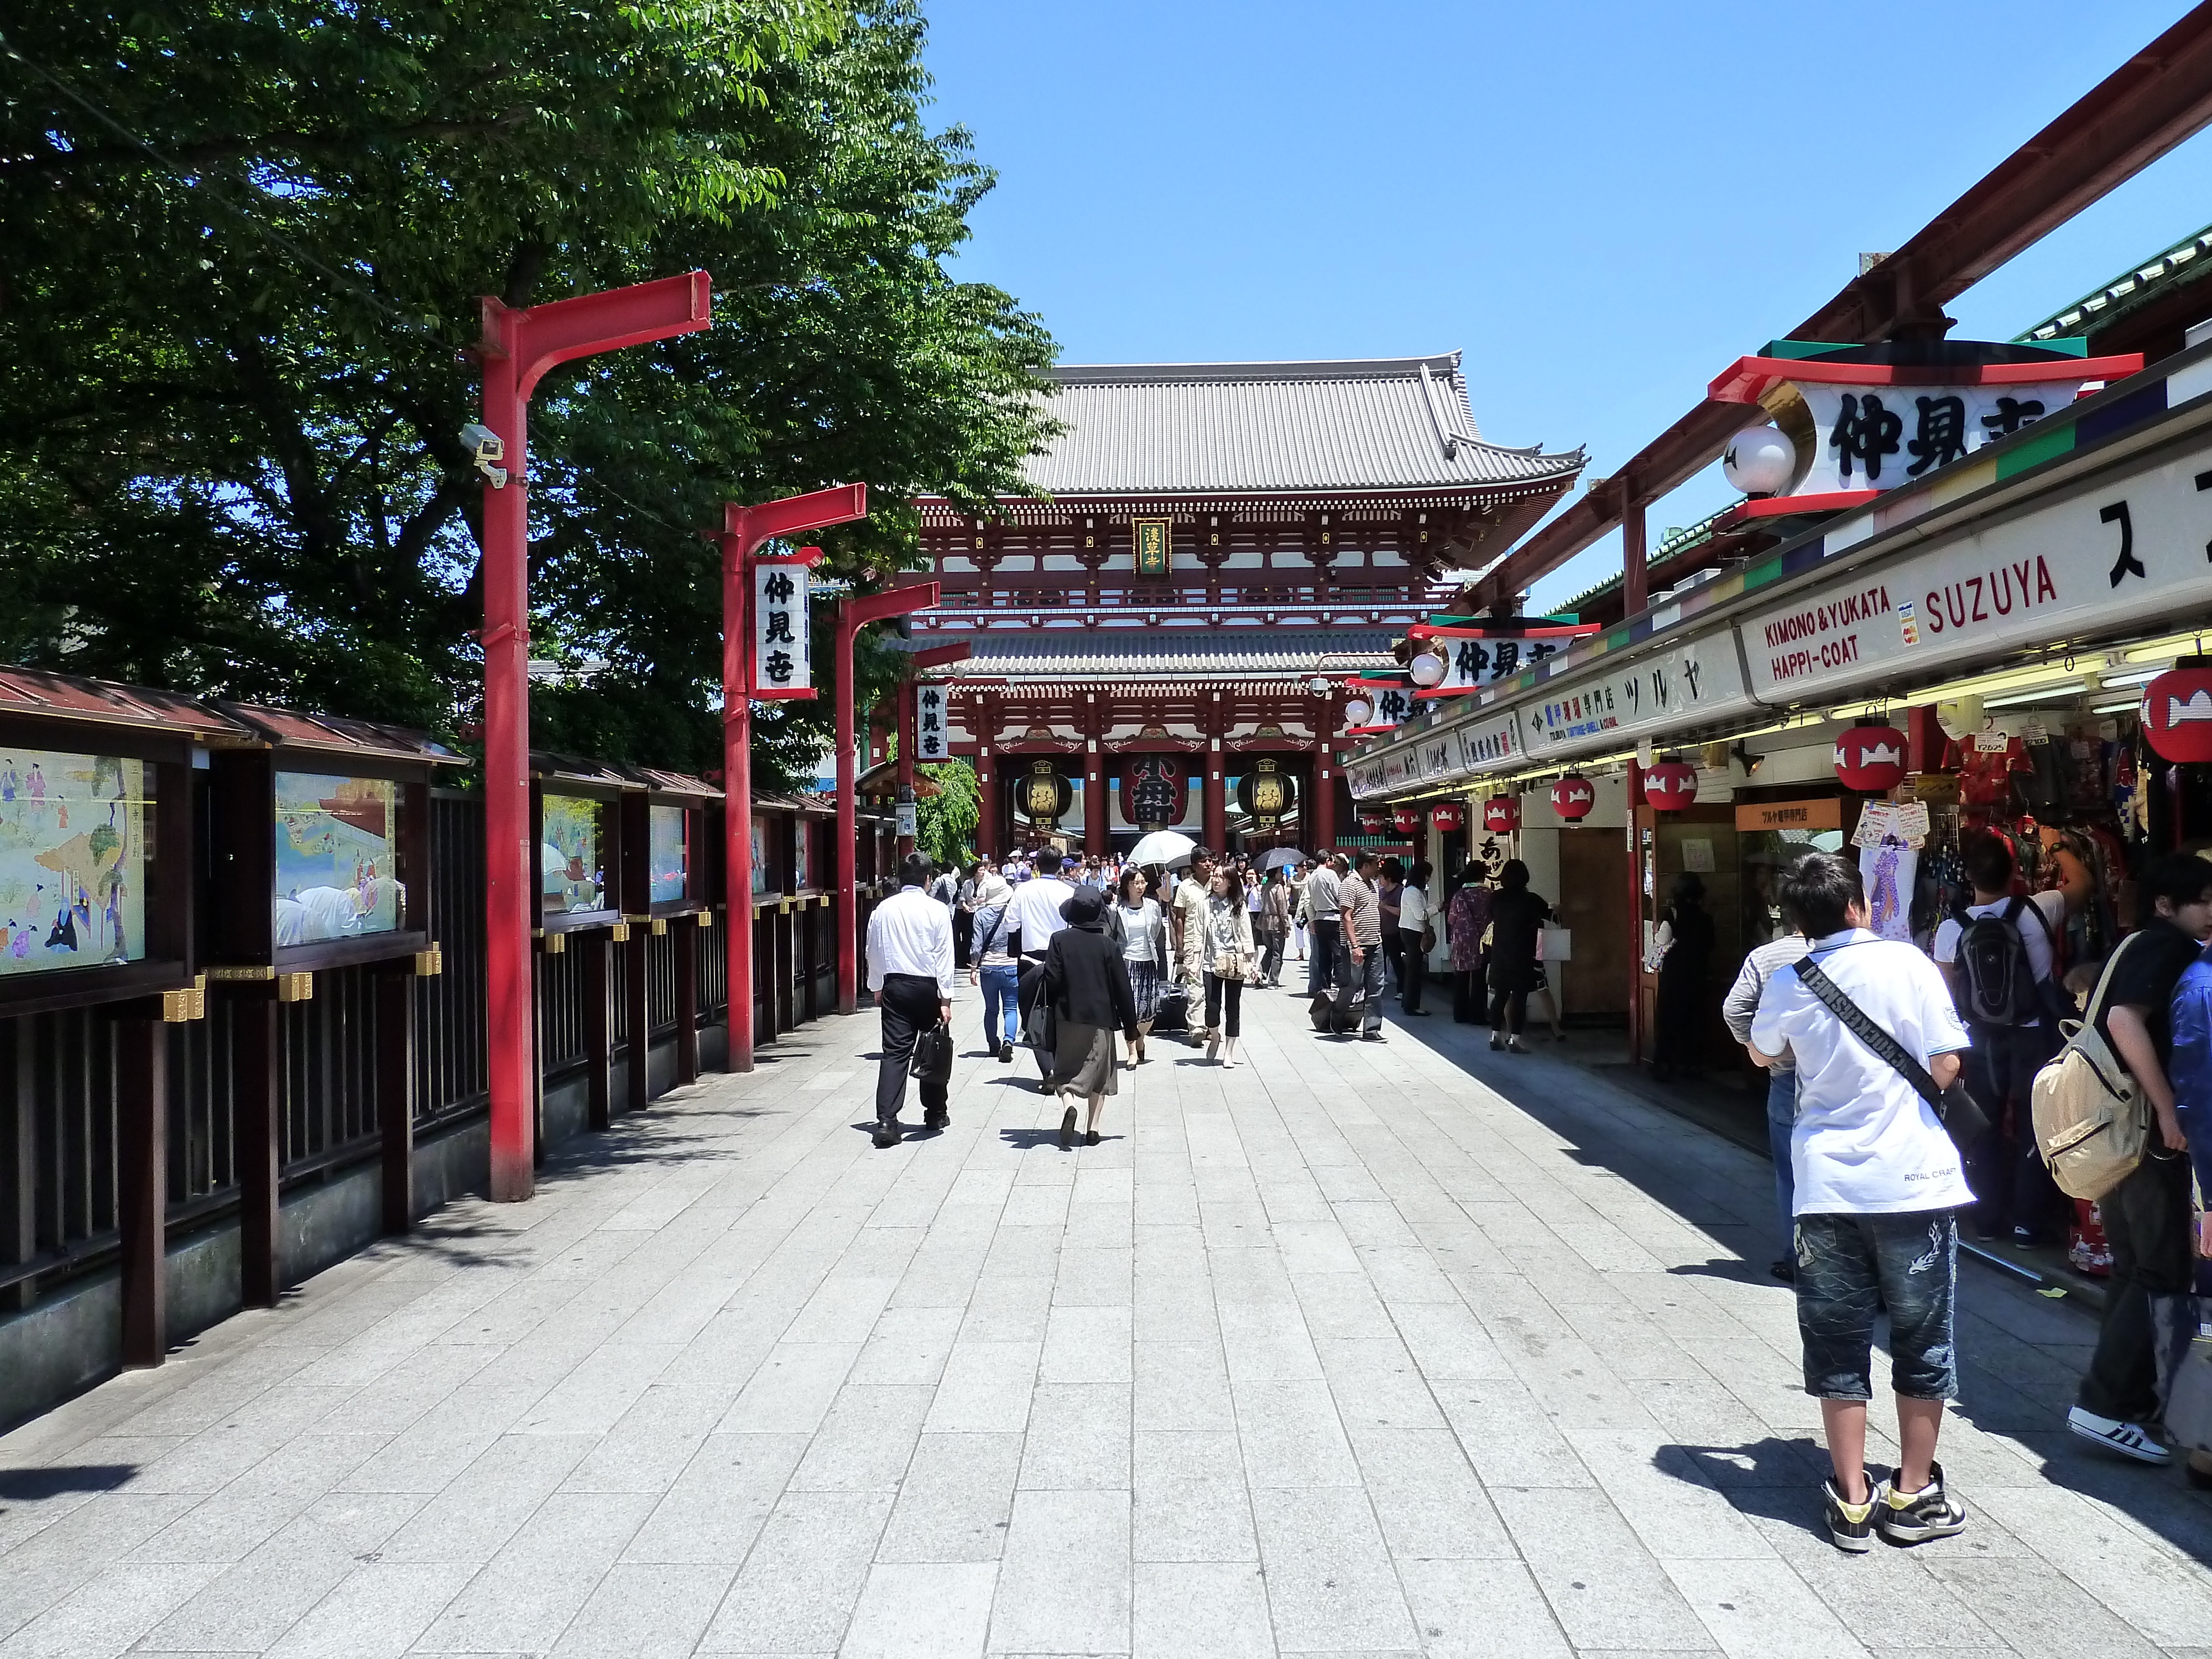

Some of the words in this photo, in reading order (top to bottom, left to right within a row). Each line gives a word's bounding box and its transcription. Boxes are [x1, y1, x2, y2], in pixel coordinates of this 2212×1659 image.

[1765, 612, 1815, 648] KIMONO
[1828, 586, 1890, 628] YUKATA
[1926, 555, 2057, 633] SUZUYA
[1771, 635, 1859, 680] HAPPI-COAT
[1905, 1173, 1930, 1181] ROYAL
[1932, 1168, 1956, 1178] CRAFT
